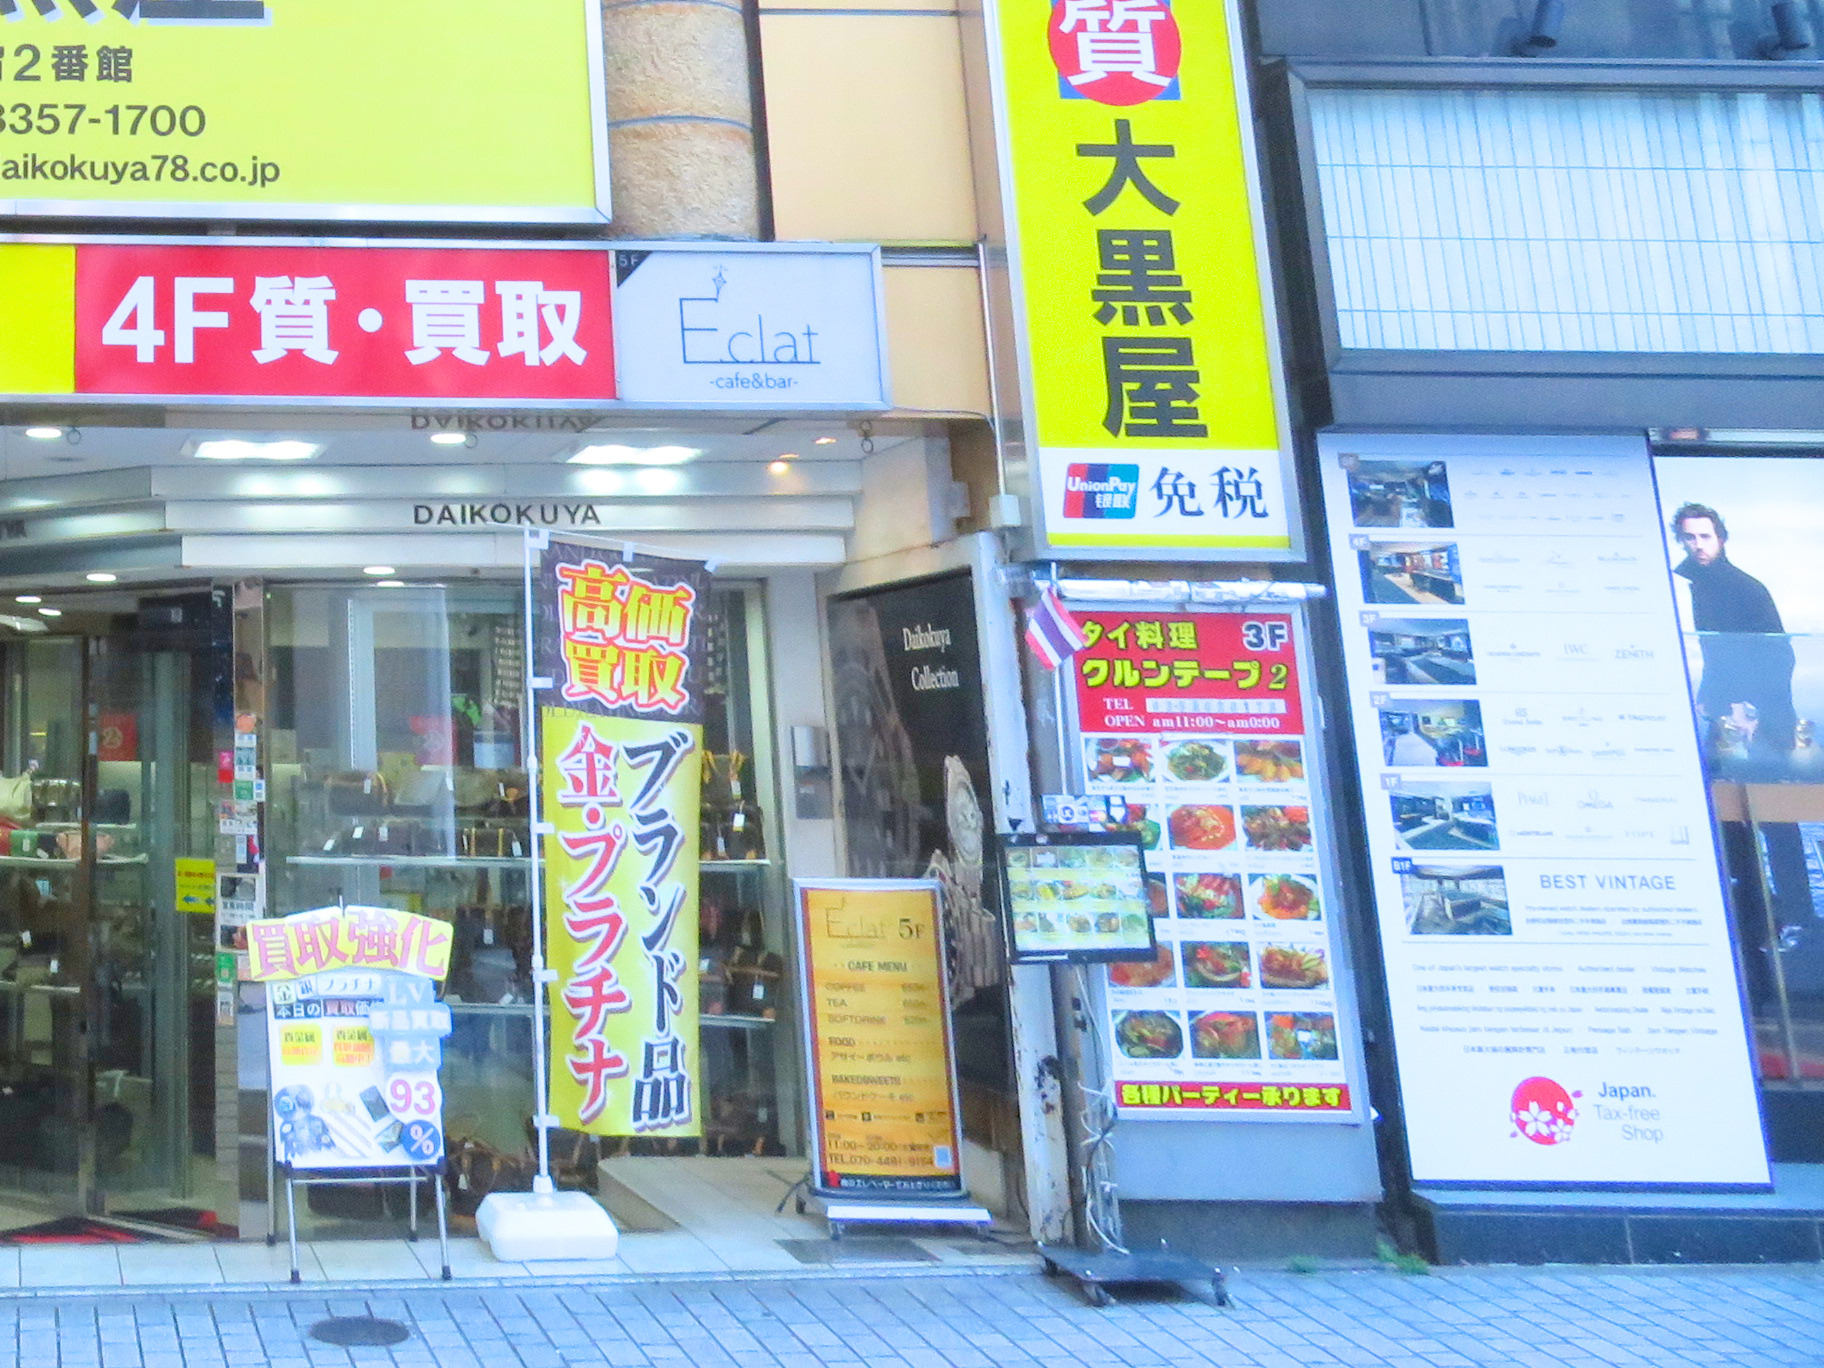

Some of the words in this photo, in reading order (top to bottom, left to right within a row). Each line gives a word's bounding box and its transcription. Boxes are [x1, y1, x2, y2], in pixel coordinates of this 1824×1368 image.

[1075, 117, 1209, 440] 大黒屋
[1067, 475, 1136, 496] UnionPay
[1148, 464, 1270, 520] 免税
[412, 502, 603, 526] DAIKOKUYA
[557, 560, 695, 647] 高価
[902, 622, 952, 653] Daikokuya
[1080, 619, 1198, 652] タイ料理
[1242, 621, 1290, 651] 3F
[1614, 647, 1655, 660] ZENITH
[562, 636, 689, 714] 買取
[911, 664, 960, 691] Collection
[1080, 657, 1262, 691] クルンテープ
[1267, 662, 1290, 690] 2
[1102, 697, 1134, 712] TEL
[1103, 714, 1146, 728] OPEN
[1539, 873, 1588, 890] BEST
[1594, 874, 1678, 891] VINTAGE
[558, 725, 632, 1127] 金・プラチナ
[622, 730, 693, 1132] ブランド品
[251, 910, 448, 978] 買取強化
[847, 960, 874, 972] CAFE
[877, 961, 908, 973] MENU
[275, 1002, 321, 1019] 本日の
[389, 1078, 436, 1115] 93
[1121, 1083, 1343, 1108] 各種パーティー承ります
[1597, 1080, 1657, 1102] Japan.
[1594, 1103, 1662, 1122] Tax-free
[1621, 1123, 1665, 1145] Shop
